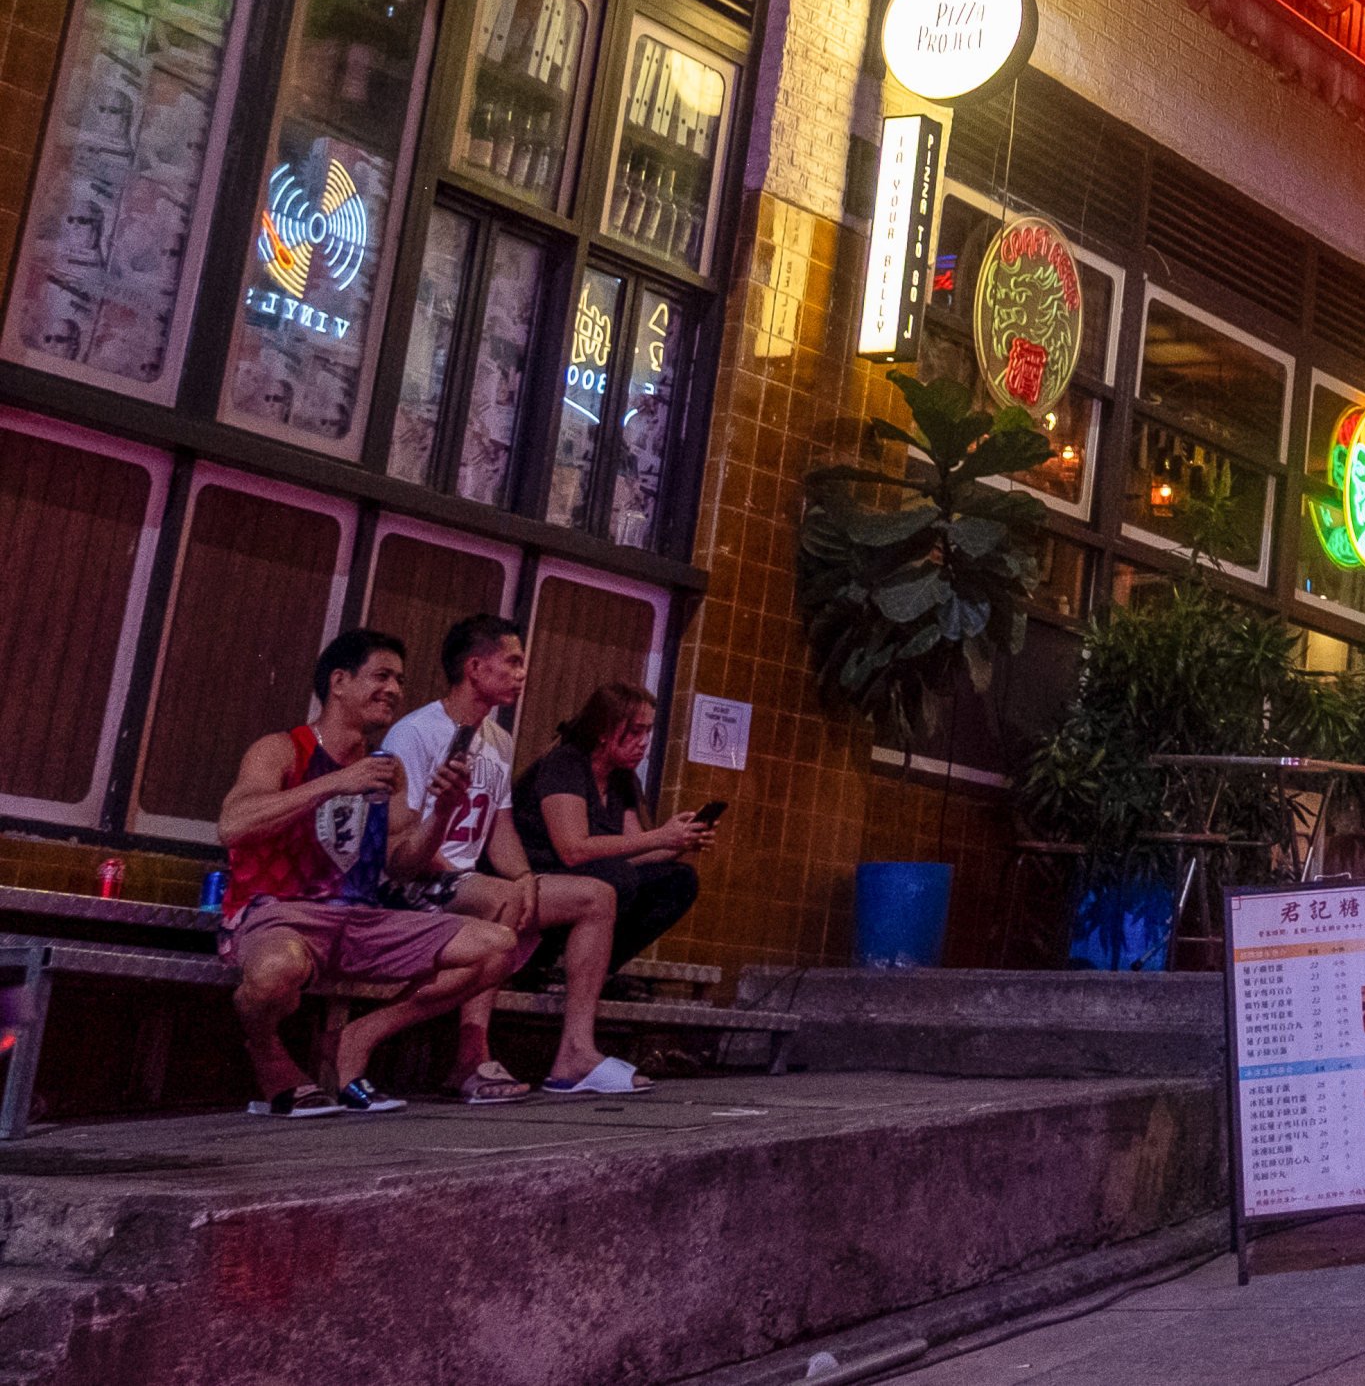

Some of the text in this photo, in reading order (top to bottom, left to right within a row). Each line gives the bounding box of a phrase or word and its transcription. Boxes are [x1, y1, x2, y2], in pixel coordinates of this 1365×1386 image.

[936, 1, 986, 28] PIZZA
[919, 134, 935, 216] PIZZA
[887, 178, 901, 241] YOUR
[914, 225, 924, 259] TO
[876, 255, 892, 334] BELLY
